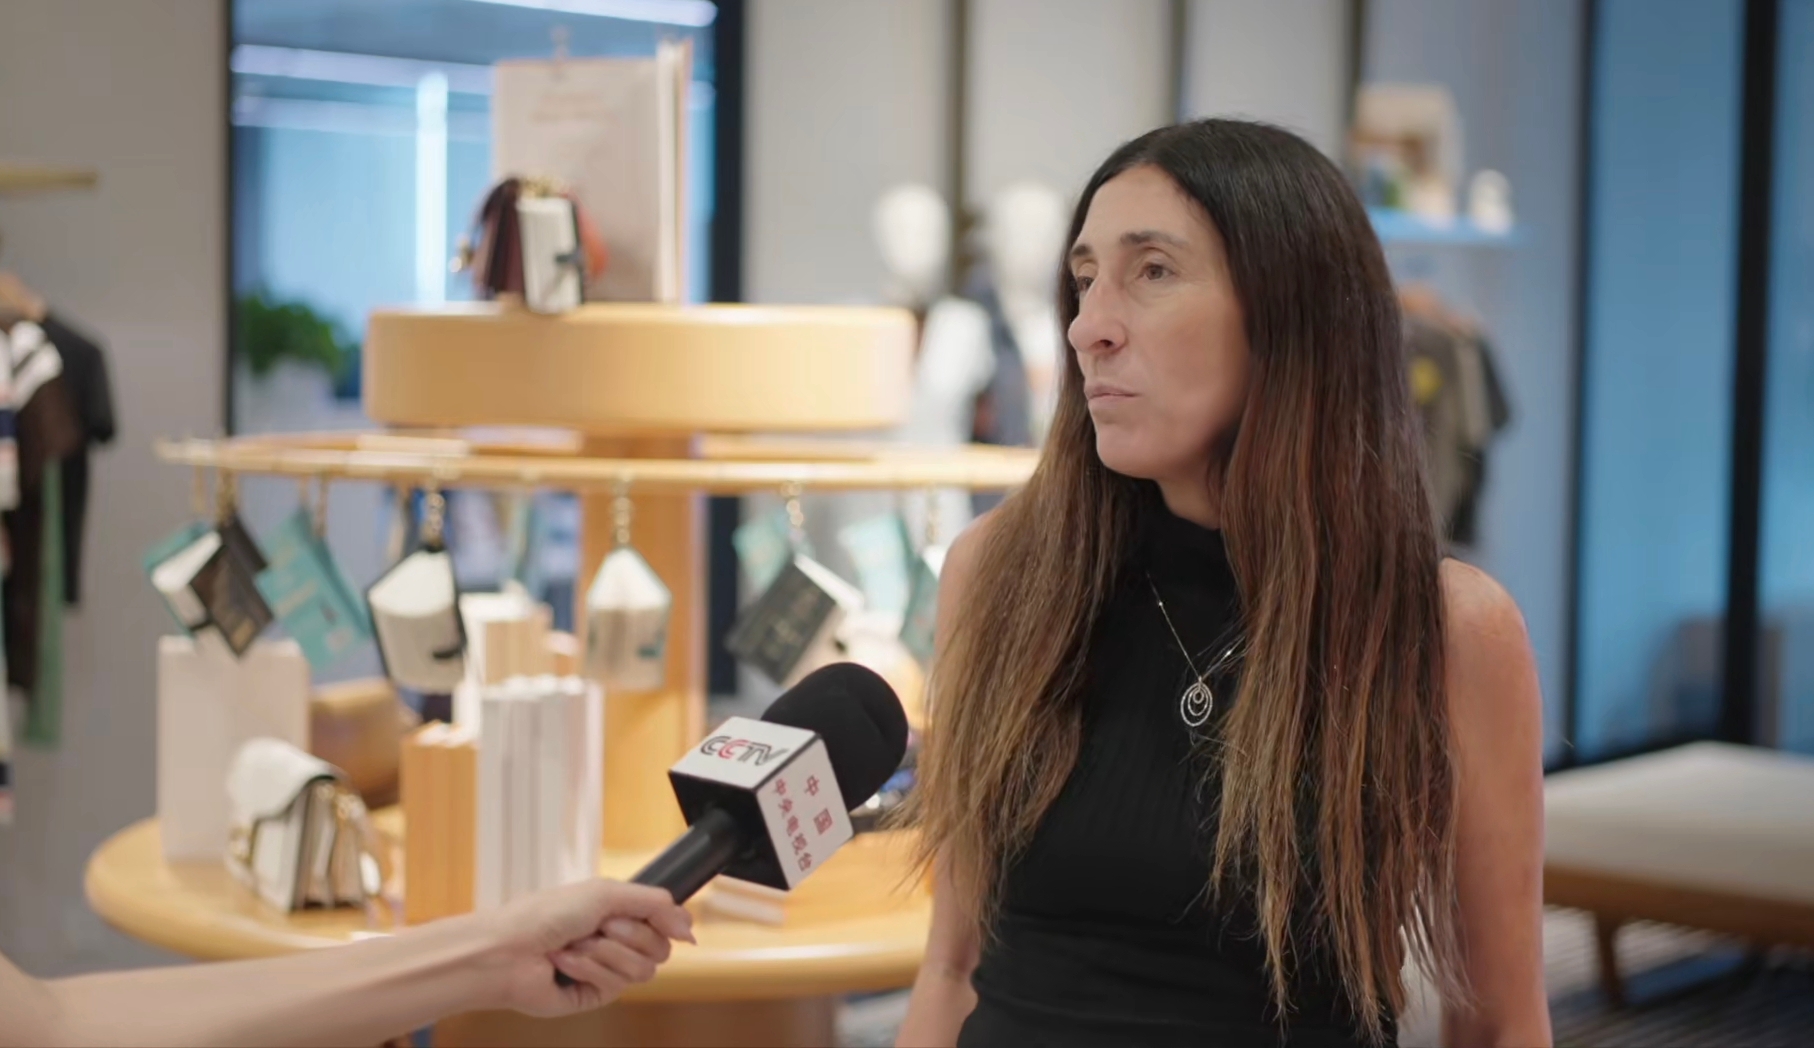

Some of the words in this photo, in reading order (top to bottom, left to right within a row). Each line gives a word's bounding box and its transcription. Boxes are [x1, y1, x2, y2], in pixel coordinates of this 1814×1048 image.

[701, 735, 788, 766] CCTV
[773, 778, 813, 872] 中央电视台
[804, 775, 833, 836] 中国
